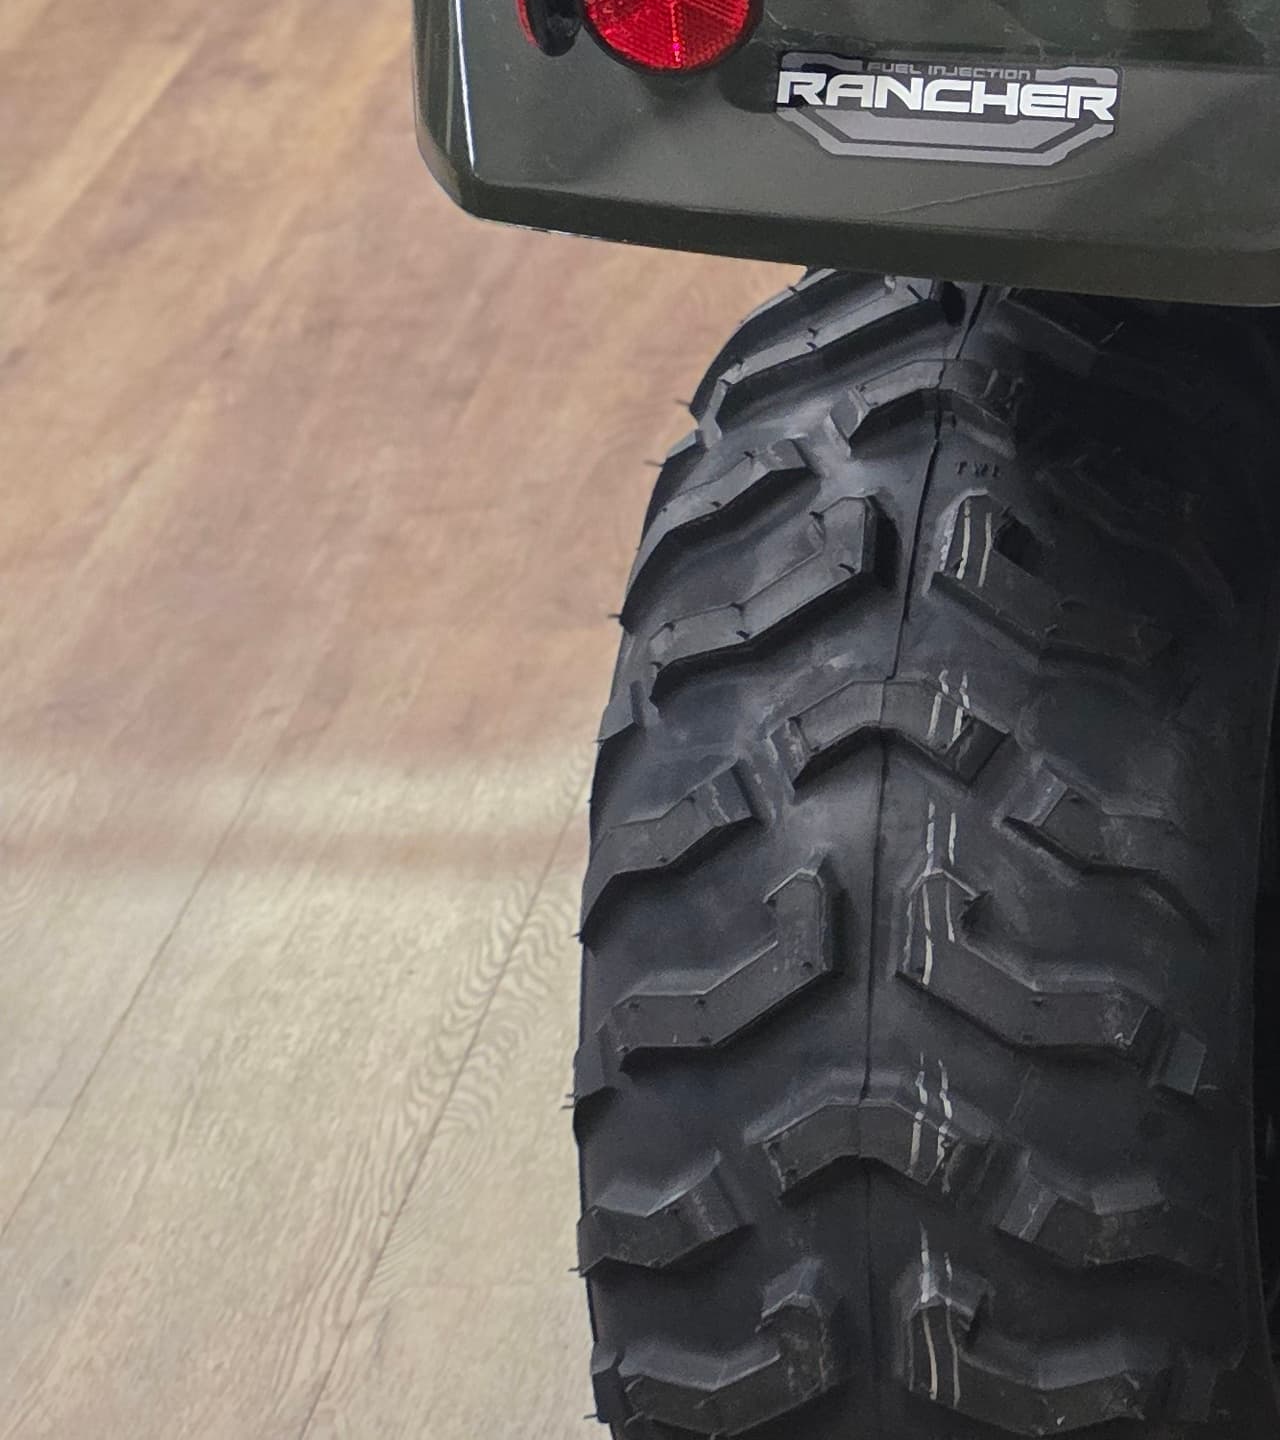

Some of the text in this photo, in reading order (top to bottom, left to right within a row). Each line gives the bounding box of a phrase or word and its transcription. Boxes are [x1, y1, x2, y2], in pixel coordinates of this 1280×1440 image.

[866, 62, 1031, 81] FUEL INJECTION
[776, 71, 1118, 121] RANCHER
